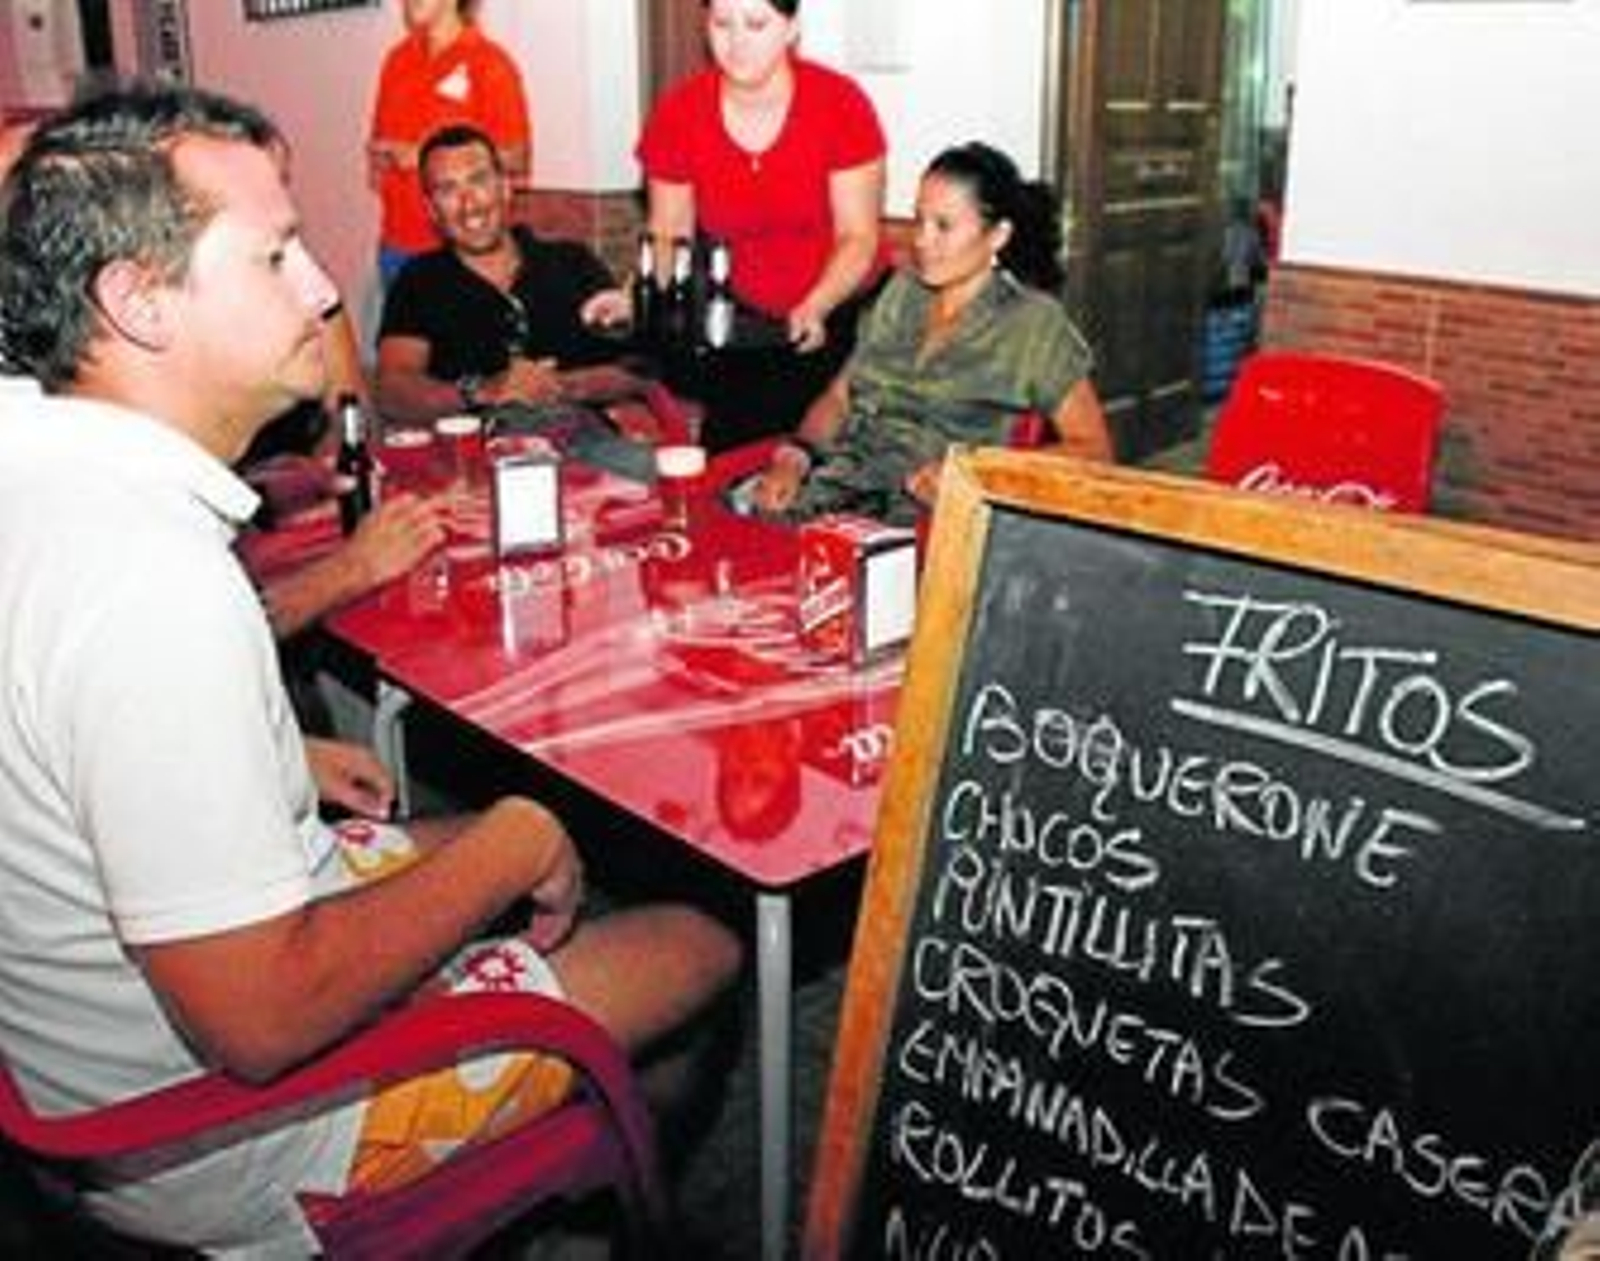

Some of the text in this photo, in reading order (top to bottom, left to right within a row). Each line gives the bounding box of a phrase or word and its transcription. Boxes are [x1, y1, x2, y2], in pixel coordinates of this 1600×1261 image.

[1183, 589, 1535, 781] FRITOS
[943, 780, 1159, 902] CHUCOS
[962, 683, 1442, 886] BOQUERONE
[933, 847, 1310, 1026] PUNTILLITAS
[913, 937, 1264, 1120] CROQUETAS
[900, 1100, 1151, 1261] ROLLITOS
